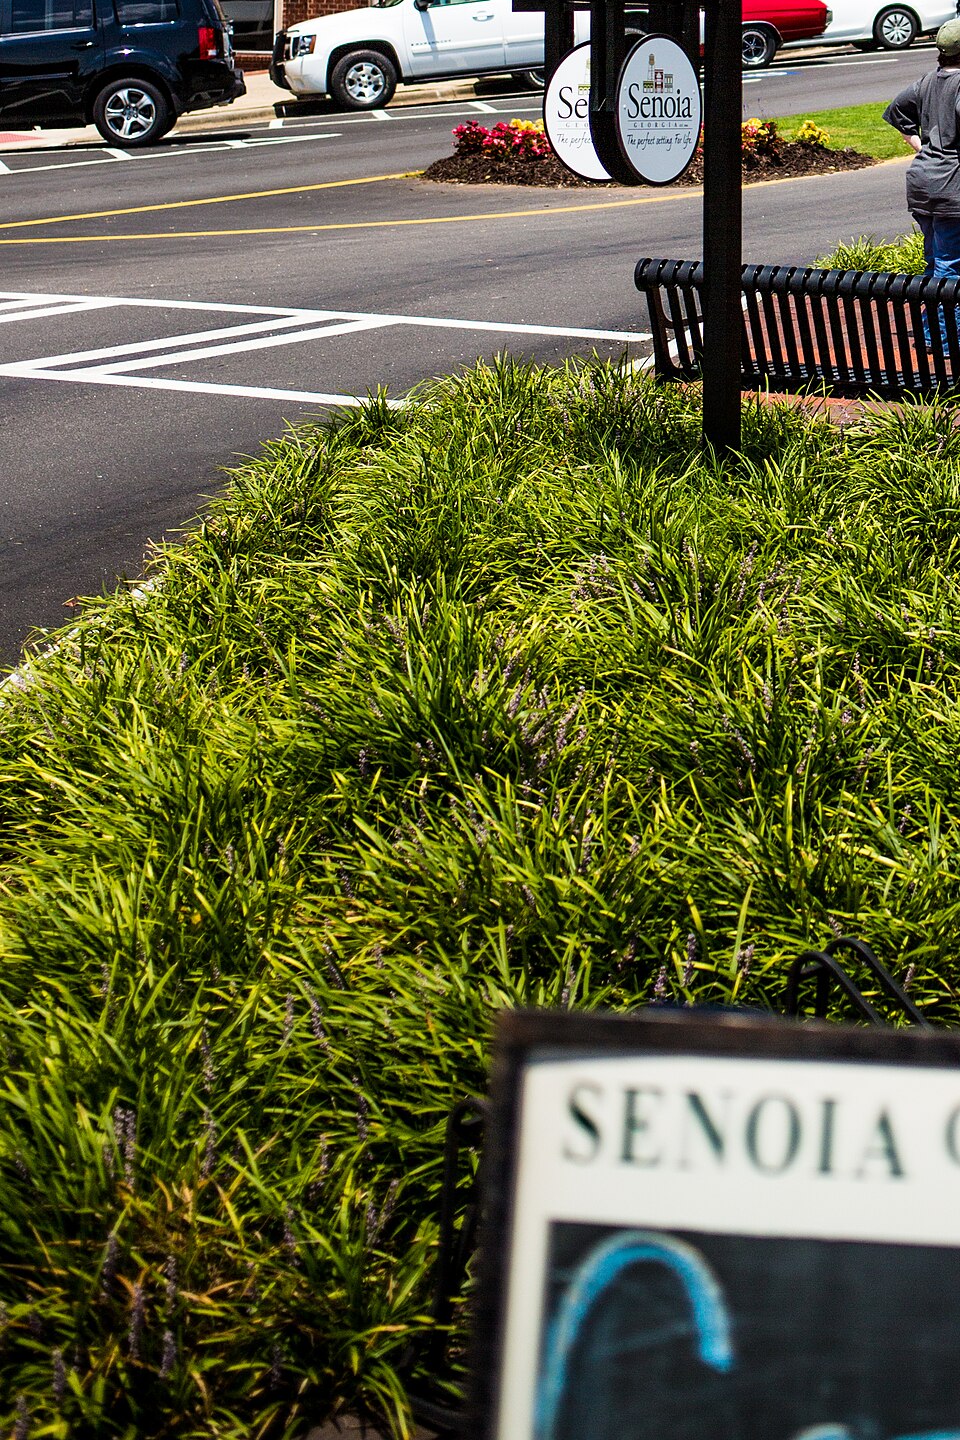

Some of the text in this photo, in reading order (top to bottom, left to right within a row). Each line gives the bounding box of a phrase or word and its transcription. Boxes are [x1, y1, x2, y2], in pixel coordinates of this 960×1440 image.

[627, 83, 693, 119] Senoia
[626, 134, 636, 145] The
[636, 131, 656, 150] perfect
[655, 135, 673, 152] setting
[562, 1080, 906, 1181] SENOIA
